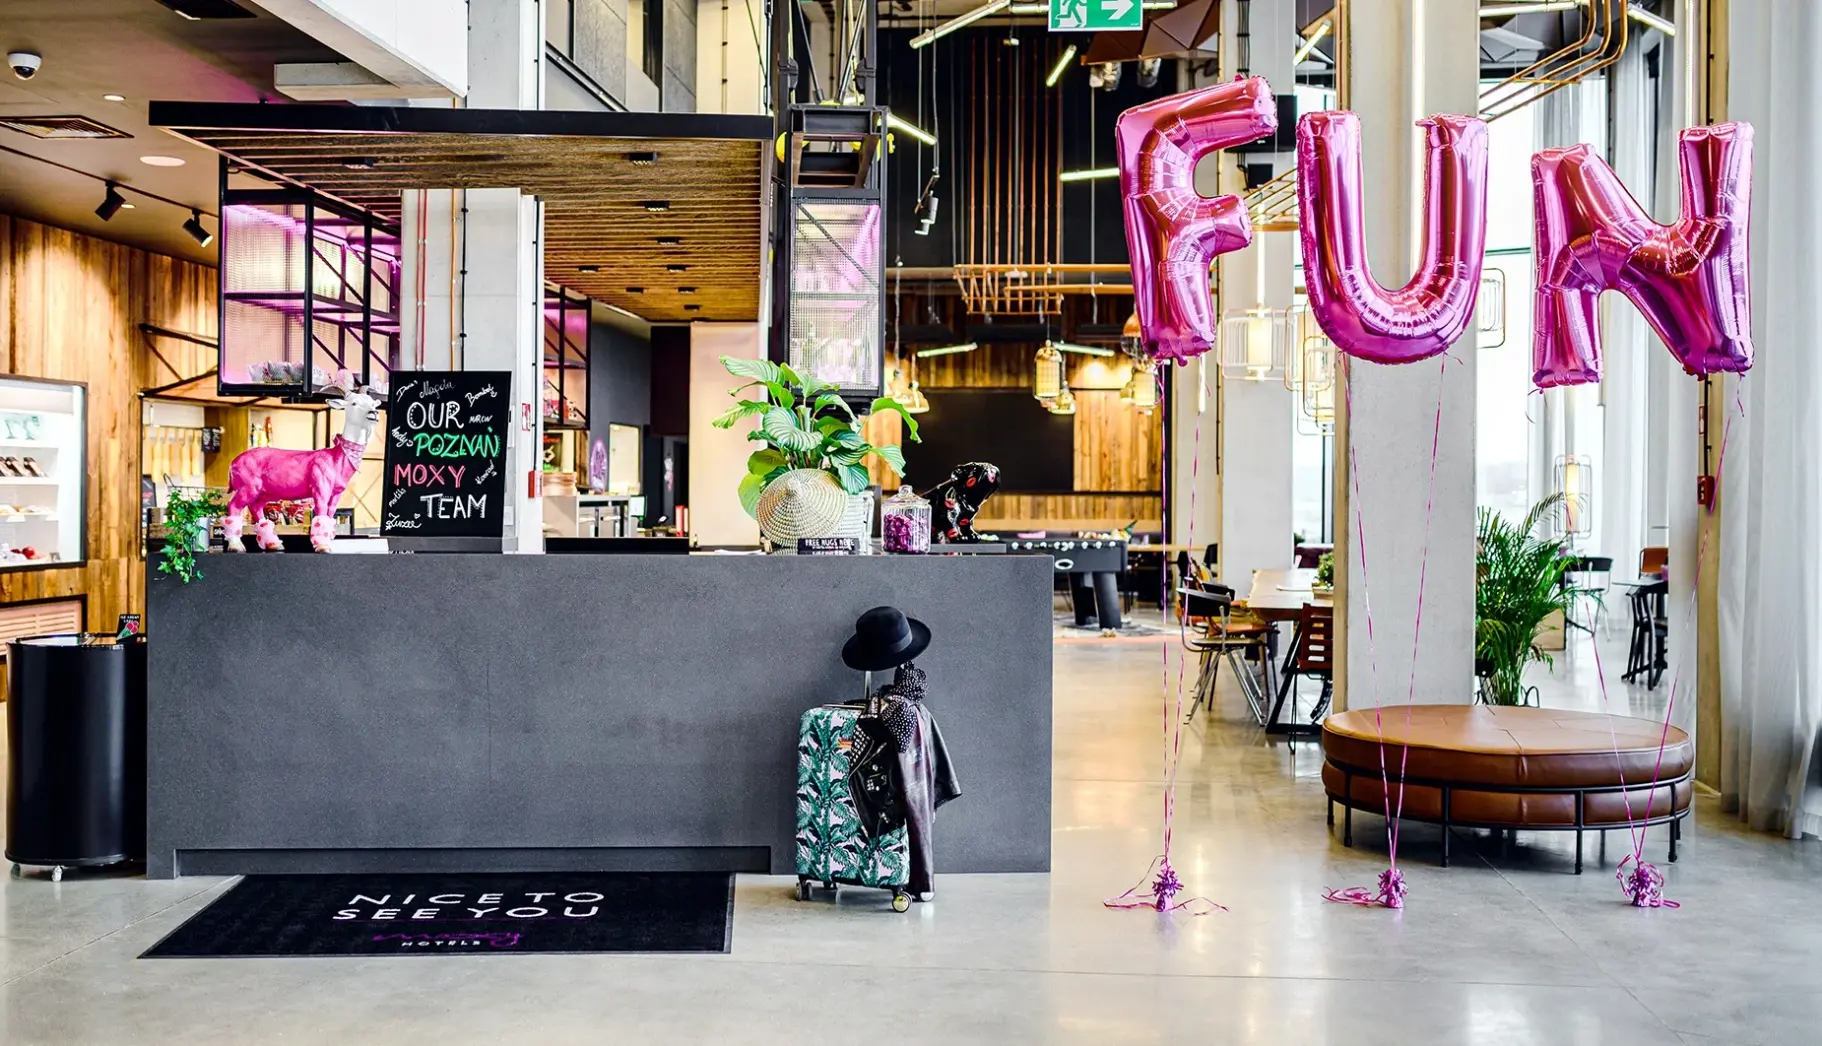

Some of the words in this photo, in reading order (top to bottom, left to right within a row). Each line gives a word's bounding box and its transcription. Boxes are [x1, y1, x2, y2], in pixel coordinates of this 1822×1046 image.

[1116, 75, 1755, 390] FUN
[406, 401, 464, 429] OUR
[414, 426, 501, 458] POZNAŃ
[394, 463, 466, 488] MOXY
[420, 493, 487, 519] TEAM
[348, 893, 503, 905] NICE
[525, 892, 604, 903] TO
[332, 908, 440, 920] SEE
[467, 906, 599, 918] YOU
